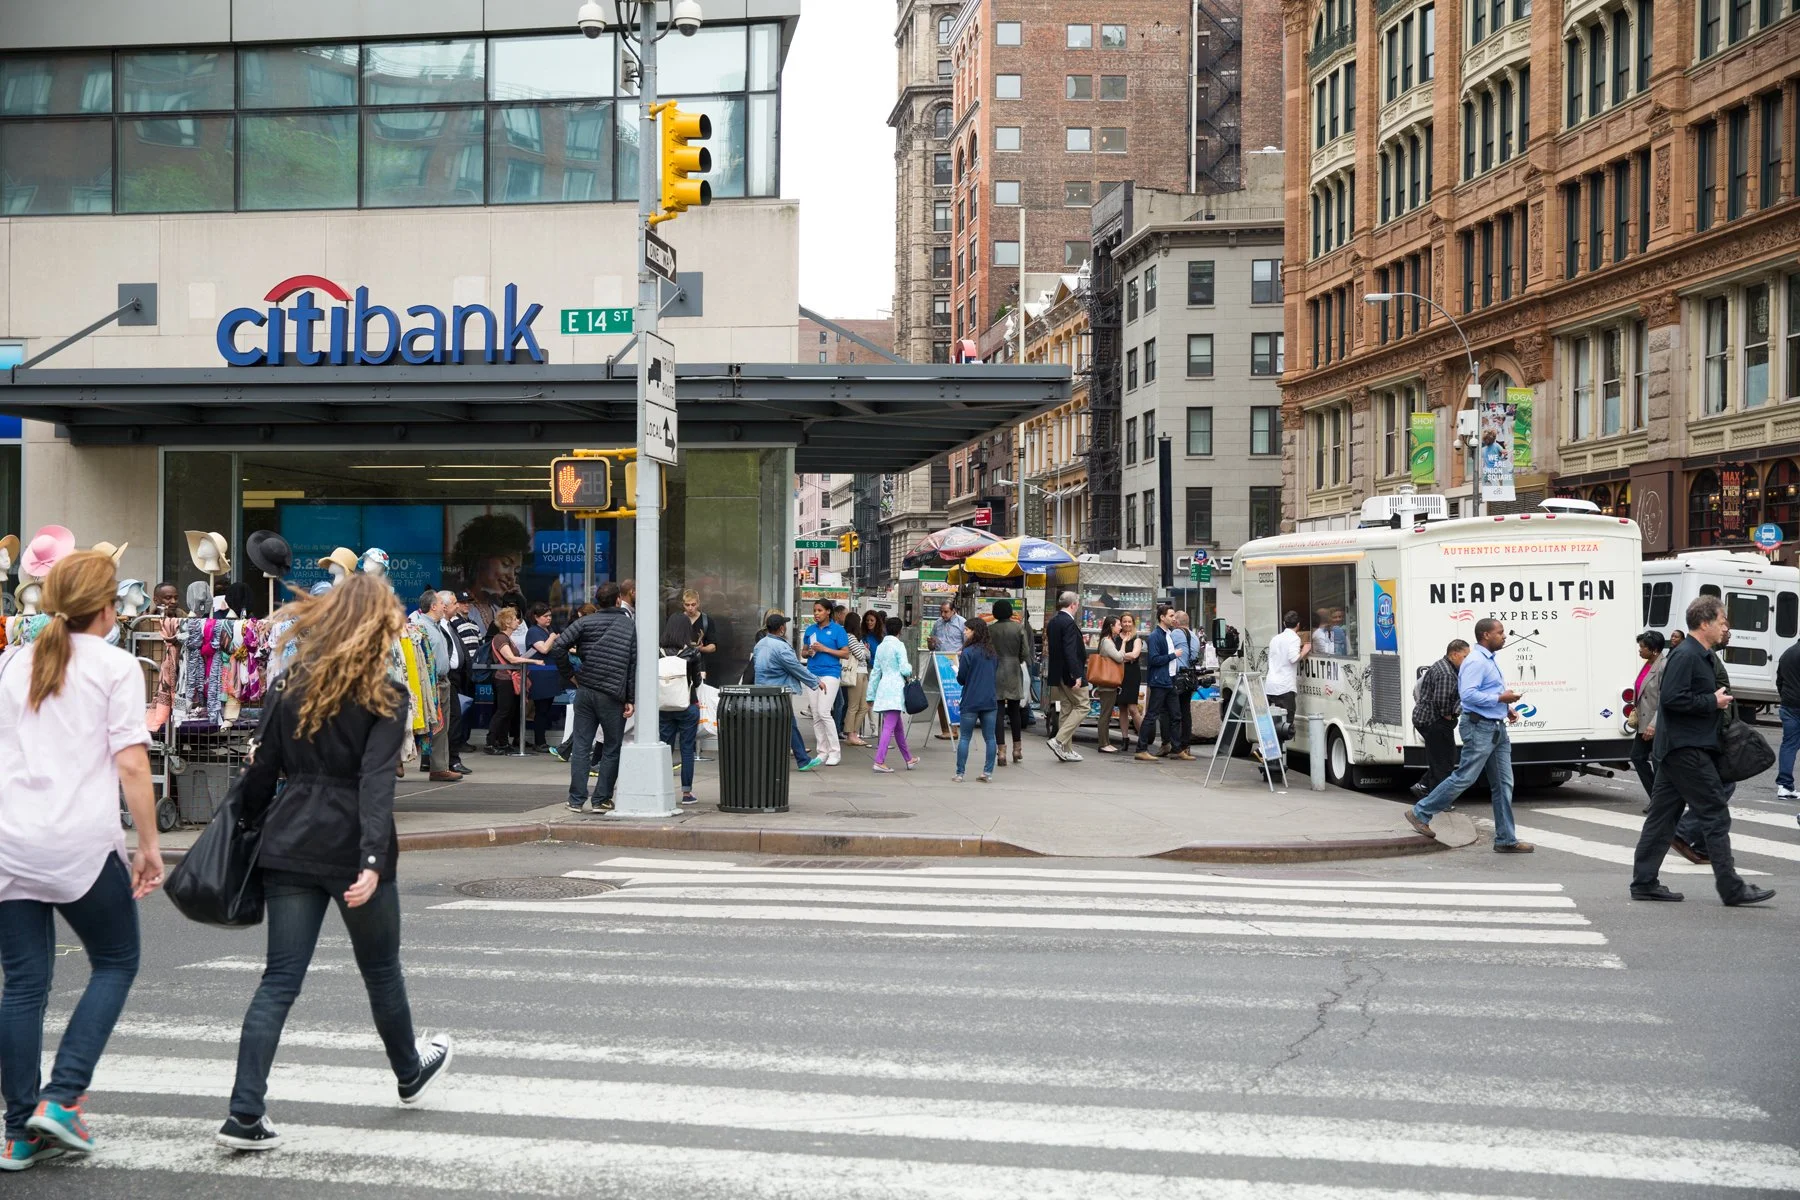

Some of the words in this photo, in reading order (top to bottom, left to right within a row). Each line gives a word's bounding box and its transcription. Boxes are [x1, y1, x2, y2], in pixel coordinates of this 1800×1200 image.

[649, 244, 659, 262] ONE
[663, 254, 673, 269] WAY
[217, 281, 544, 366] citibank
[568, 311, 579, 332] E
[587, 311, 607, 332] 14
[613, 310, 628, 322] ST
[662, 356, 674, 374] TRUCK
[662, 382, 675, 400] ROUTE
[1507, 393, 1532, 401] YOGA
[1412, 417, 1434, 425] SHOP
[646, 422, 662, 440] LOCAL
[1722, 471, 1740, 480] MAX
[1723, 521, 1740, 529] WIDE
[541, 542, 603, 554] UPGRAE
[1443, 546, 1500, 556] AUTHENTIC
[1504, 545, 1567, 554] NEAPOLITAN
[1571, 543, 1599, 552] PIZZA
[1176, 556, 1233, 570] CAS
[388, 571, 414, 579] RIABLE
[416, 571, 431, 579] APR
[403, 579, 423, 587] THAT
[1430, 579, 1615, 604] NEAPOLITAN
[1380, 601, 1391, 615] citi
[1489, 610, 1559, 621] EXPRESS
[1297, 658, 1339, 681] POLITAN
[1523, 720, 1546, 728] Energy
